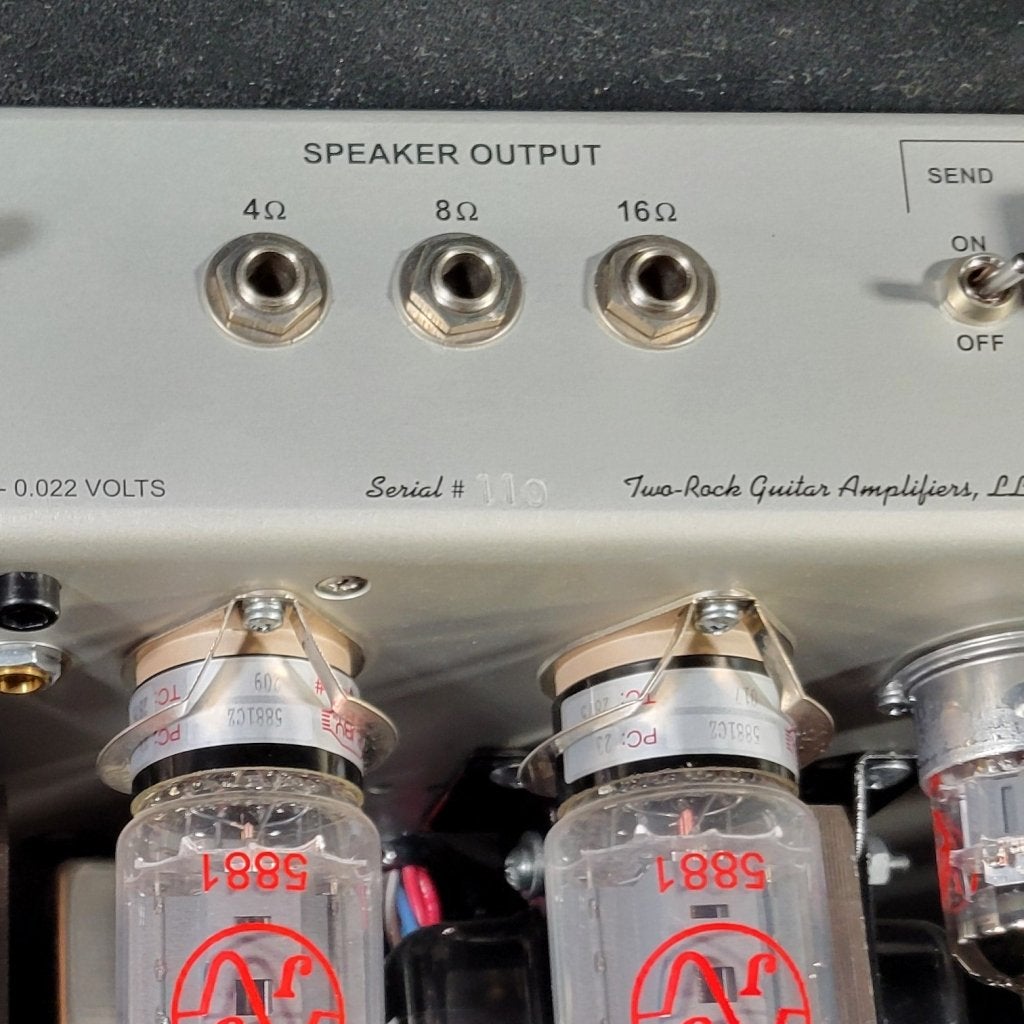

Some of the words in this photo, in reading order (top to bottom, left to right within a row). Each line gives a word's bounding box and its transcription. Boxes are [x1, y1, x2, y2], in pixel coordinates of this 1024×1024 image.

[303, 143, 461, 165] SPEAKER
[470, 143, 602, 166] OUTPUT
[928, 167, 994, 184] SEND
[243, 200, 287, 222] 4Ω
[435, 200, 479, 222] 8Ω
[618, 201, 678, 224] 16Ω
[951, 235, 987, 252] ON
[957, 335, 1004, 352] OFF
[14, 478, 78, 498] 0.022
[84, 478, 166, 498] VOLTS
[365, 475, 444, 499] Serial
[452, 479, 465, 499] #
[623, 474, 743, 499] Two-Rock
[750, 475, 831, 503] Guitar
[838, 474, 979, 506] Amplifiers,
[621, 727, 658, 749] PC:
[201, 852, 309, 893] 5881
[654, 851, 766, 893] 5881
